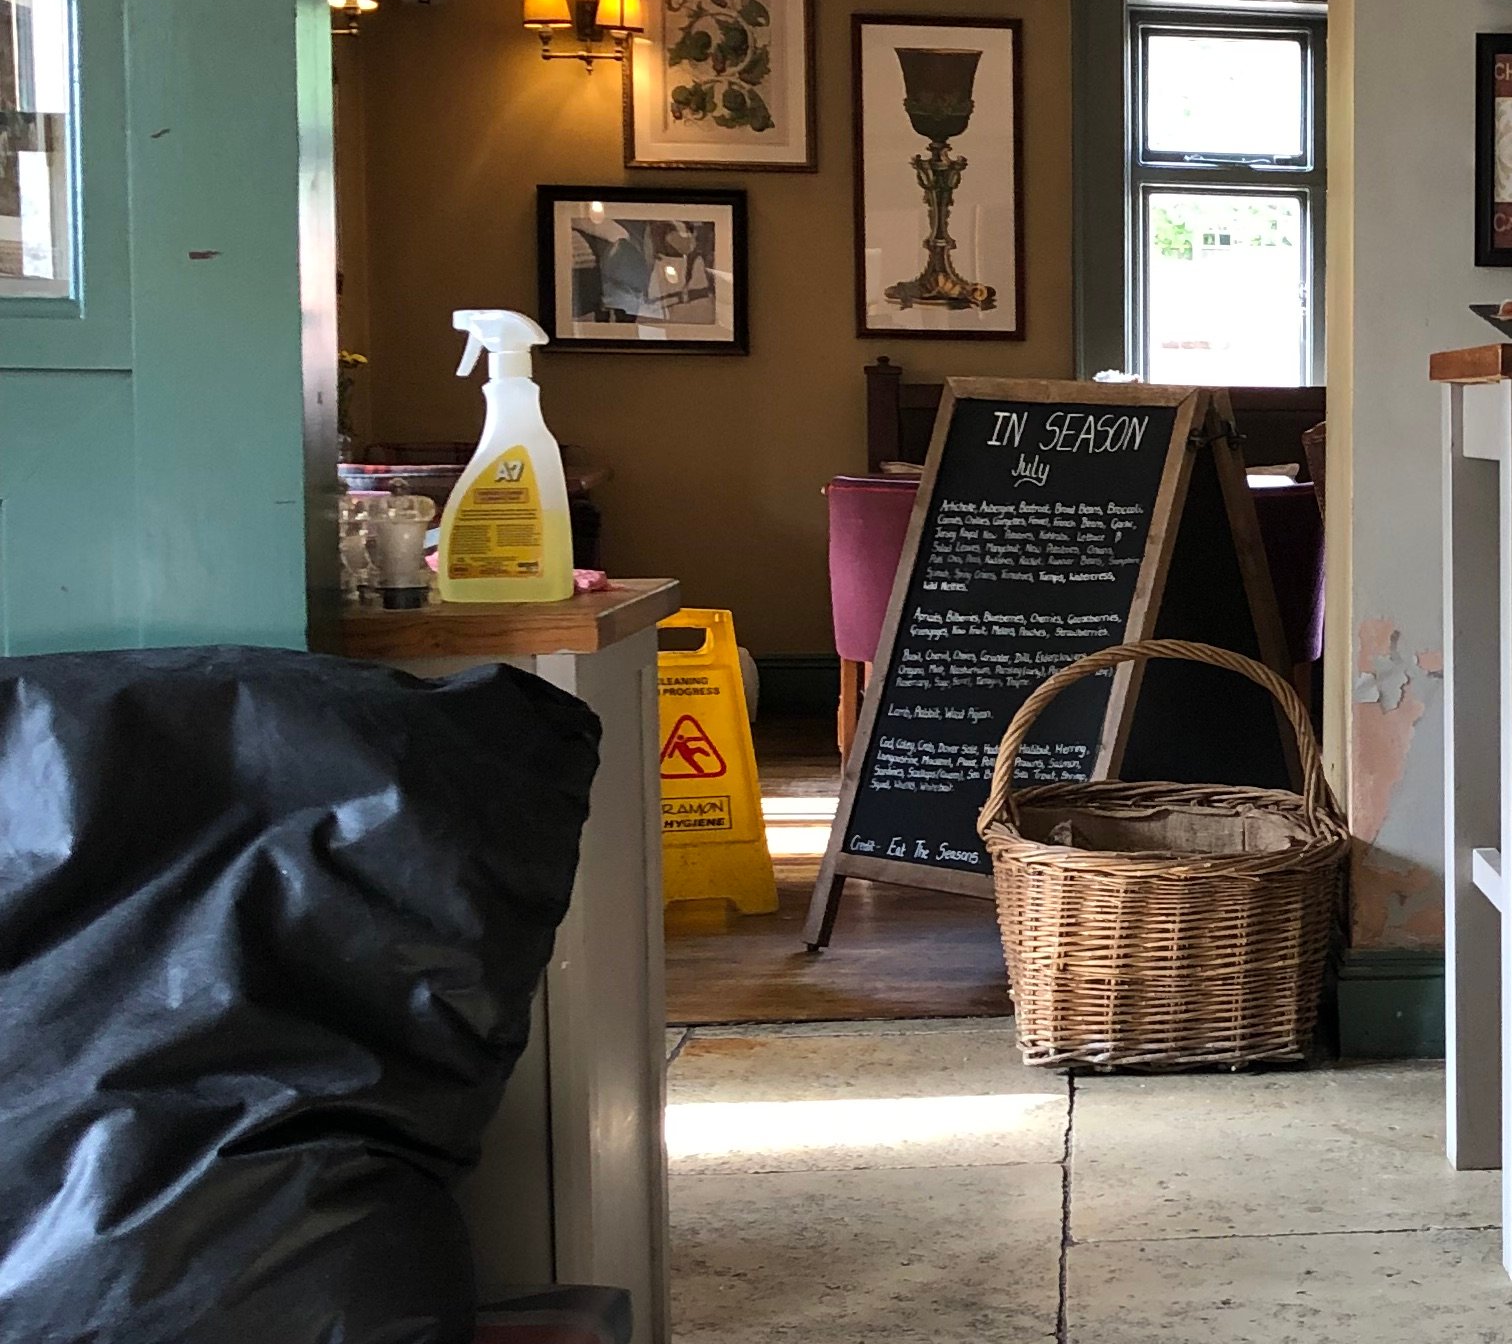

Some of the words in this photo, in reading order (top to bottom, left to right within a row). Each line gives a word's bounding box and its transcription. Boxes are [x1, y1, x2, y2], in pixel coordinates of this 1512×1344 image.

[987, 411, 1028, 447] IN
[1039, 411, 1149, 453] SEASON
[1011, 453, 1050, 487] July
[663, 687, 720, 696] PROGRESS
[664, 818, 725, 829] HYGIENE
[886, 837, 906, 857] Eat
[914, 839, 930, 859] The
